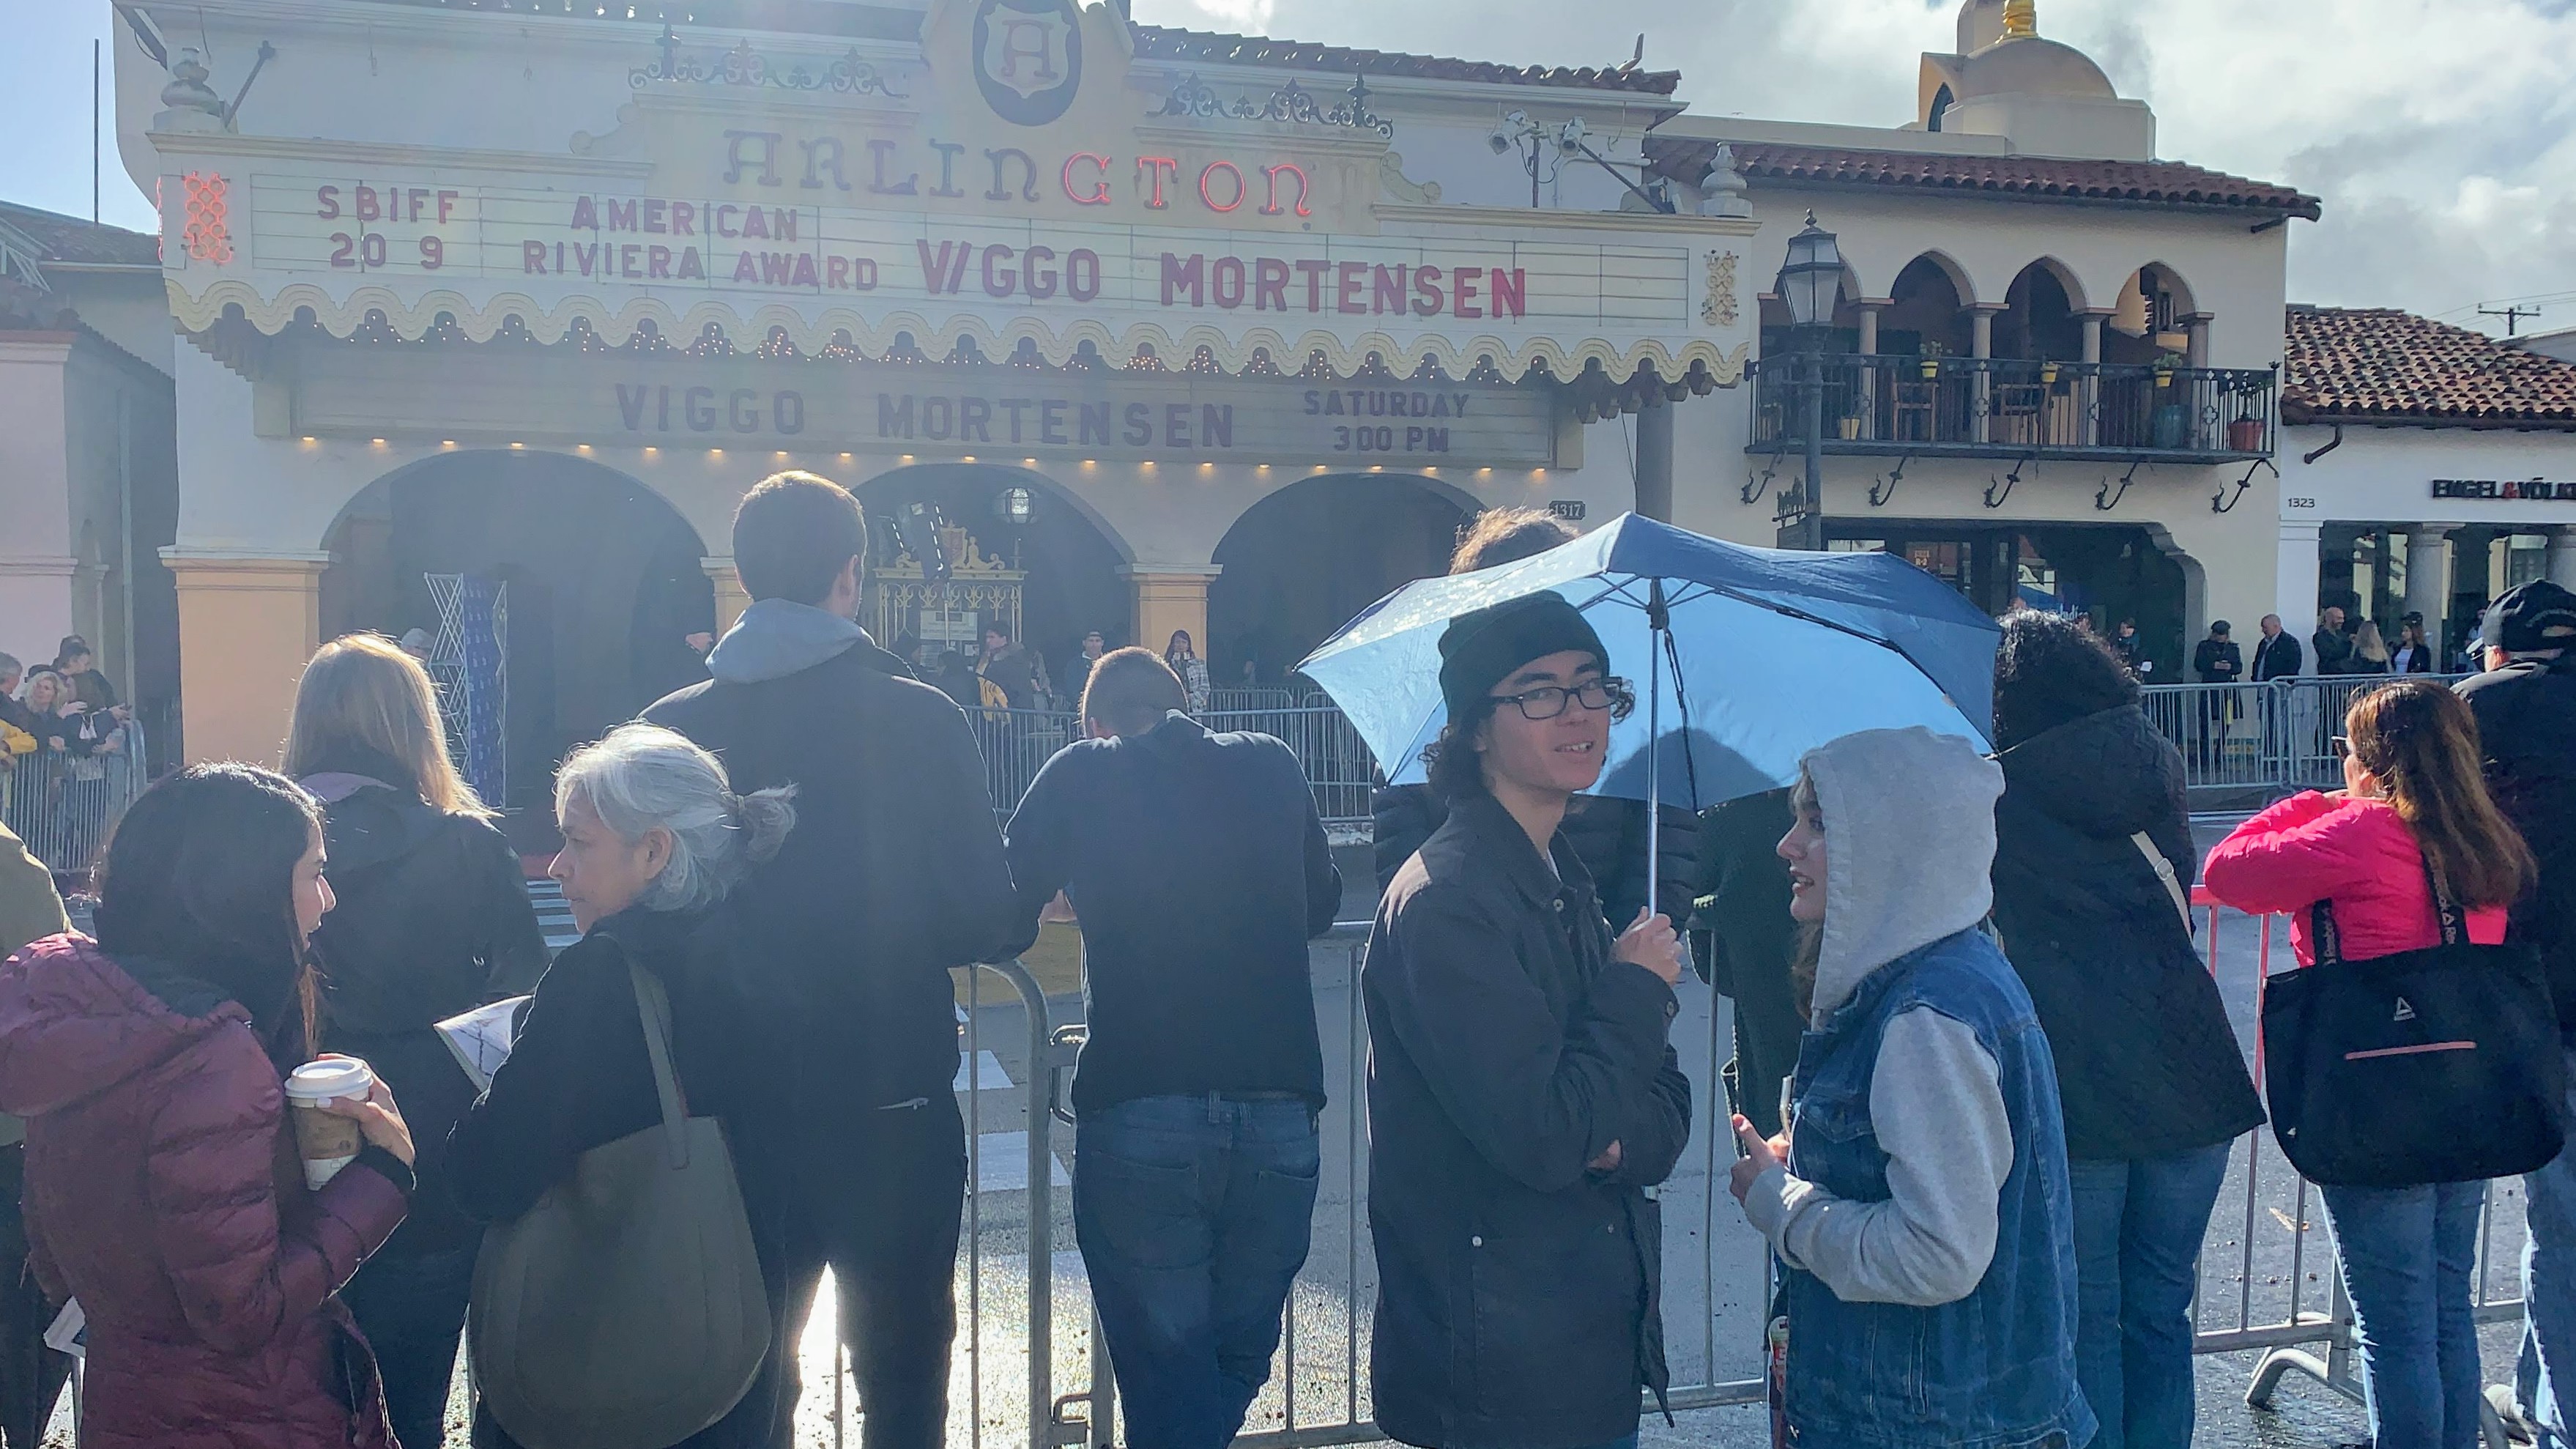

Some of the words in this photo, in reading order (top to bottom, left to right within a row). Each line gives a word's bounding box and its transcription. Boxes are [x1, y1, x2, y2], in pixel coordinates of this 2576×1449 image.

[318, 185, 459, 223] SBIFF
[571, 196, 798, 242] AMERICAN
[523, 240, 705, 281] RIVIERA
[734, 251, 878, 290] AWARD
[916, 238, 1101, 302] VIGGO
[1160, 251, 1526, 319] MORTENSEN
[615, 382, 805, 435] VIGGO
[879, 393, 1233, 448] MORTENSEN
[1304, 390, 1469, 418] SATURDAY
[1406, 426, 1449, 453] PM
[1554, 503, 1581, 516] 1317
[2288, 497, 2315, 508] 1323
